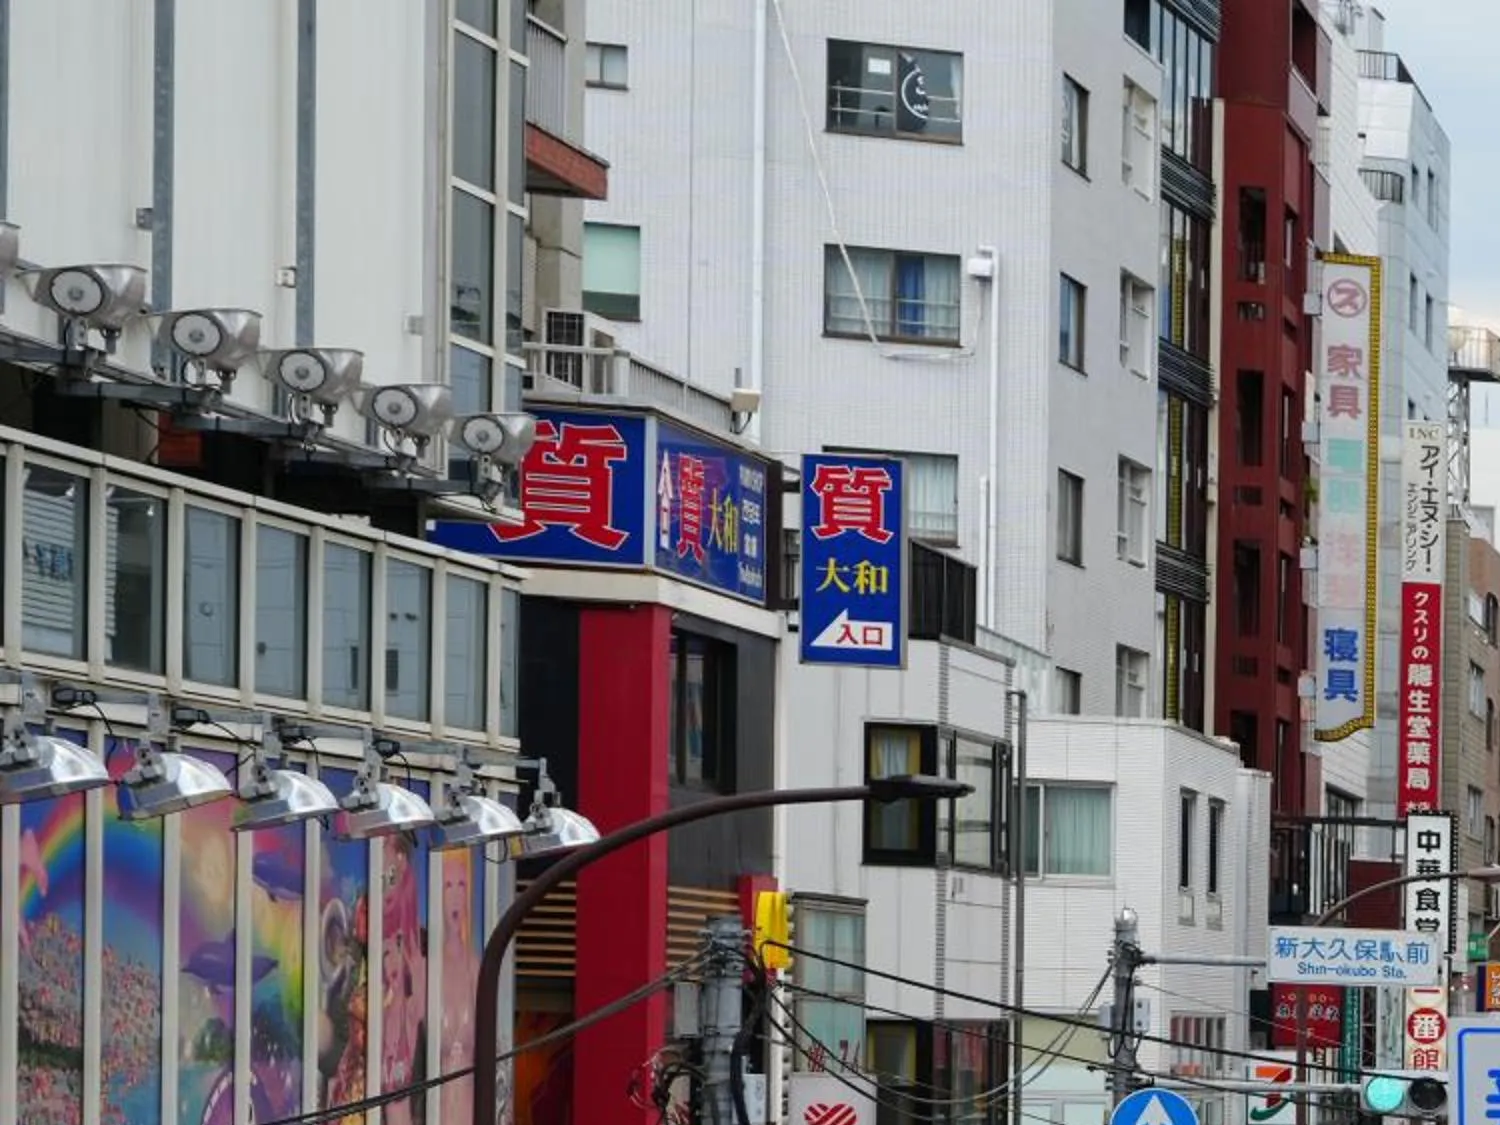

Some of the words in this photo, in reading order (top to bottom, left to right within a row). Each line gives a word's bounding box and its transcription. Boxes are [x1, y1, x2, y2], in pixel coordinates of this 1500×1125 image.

[1327, 344, 1363, 420] 家具
[489, 420, 630, 550] 質
[811, 463, 894, 543] 質
[816, 557, 889, 596] 大和
[835, 622, 884, 647] 入口
[1324, 628, 1359, 702] 寝具
[1274, 936, 1430, 966] 新大久保駅前
[1297, 962, 1377, 978] Shin-okubo
[1382, 964, 1408, 980] Sta.
